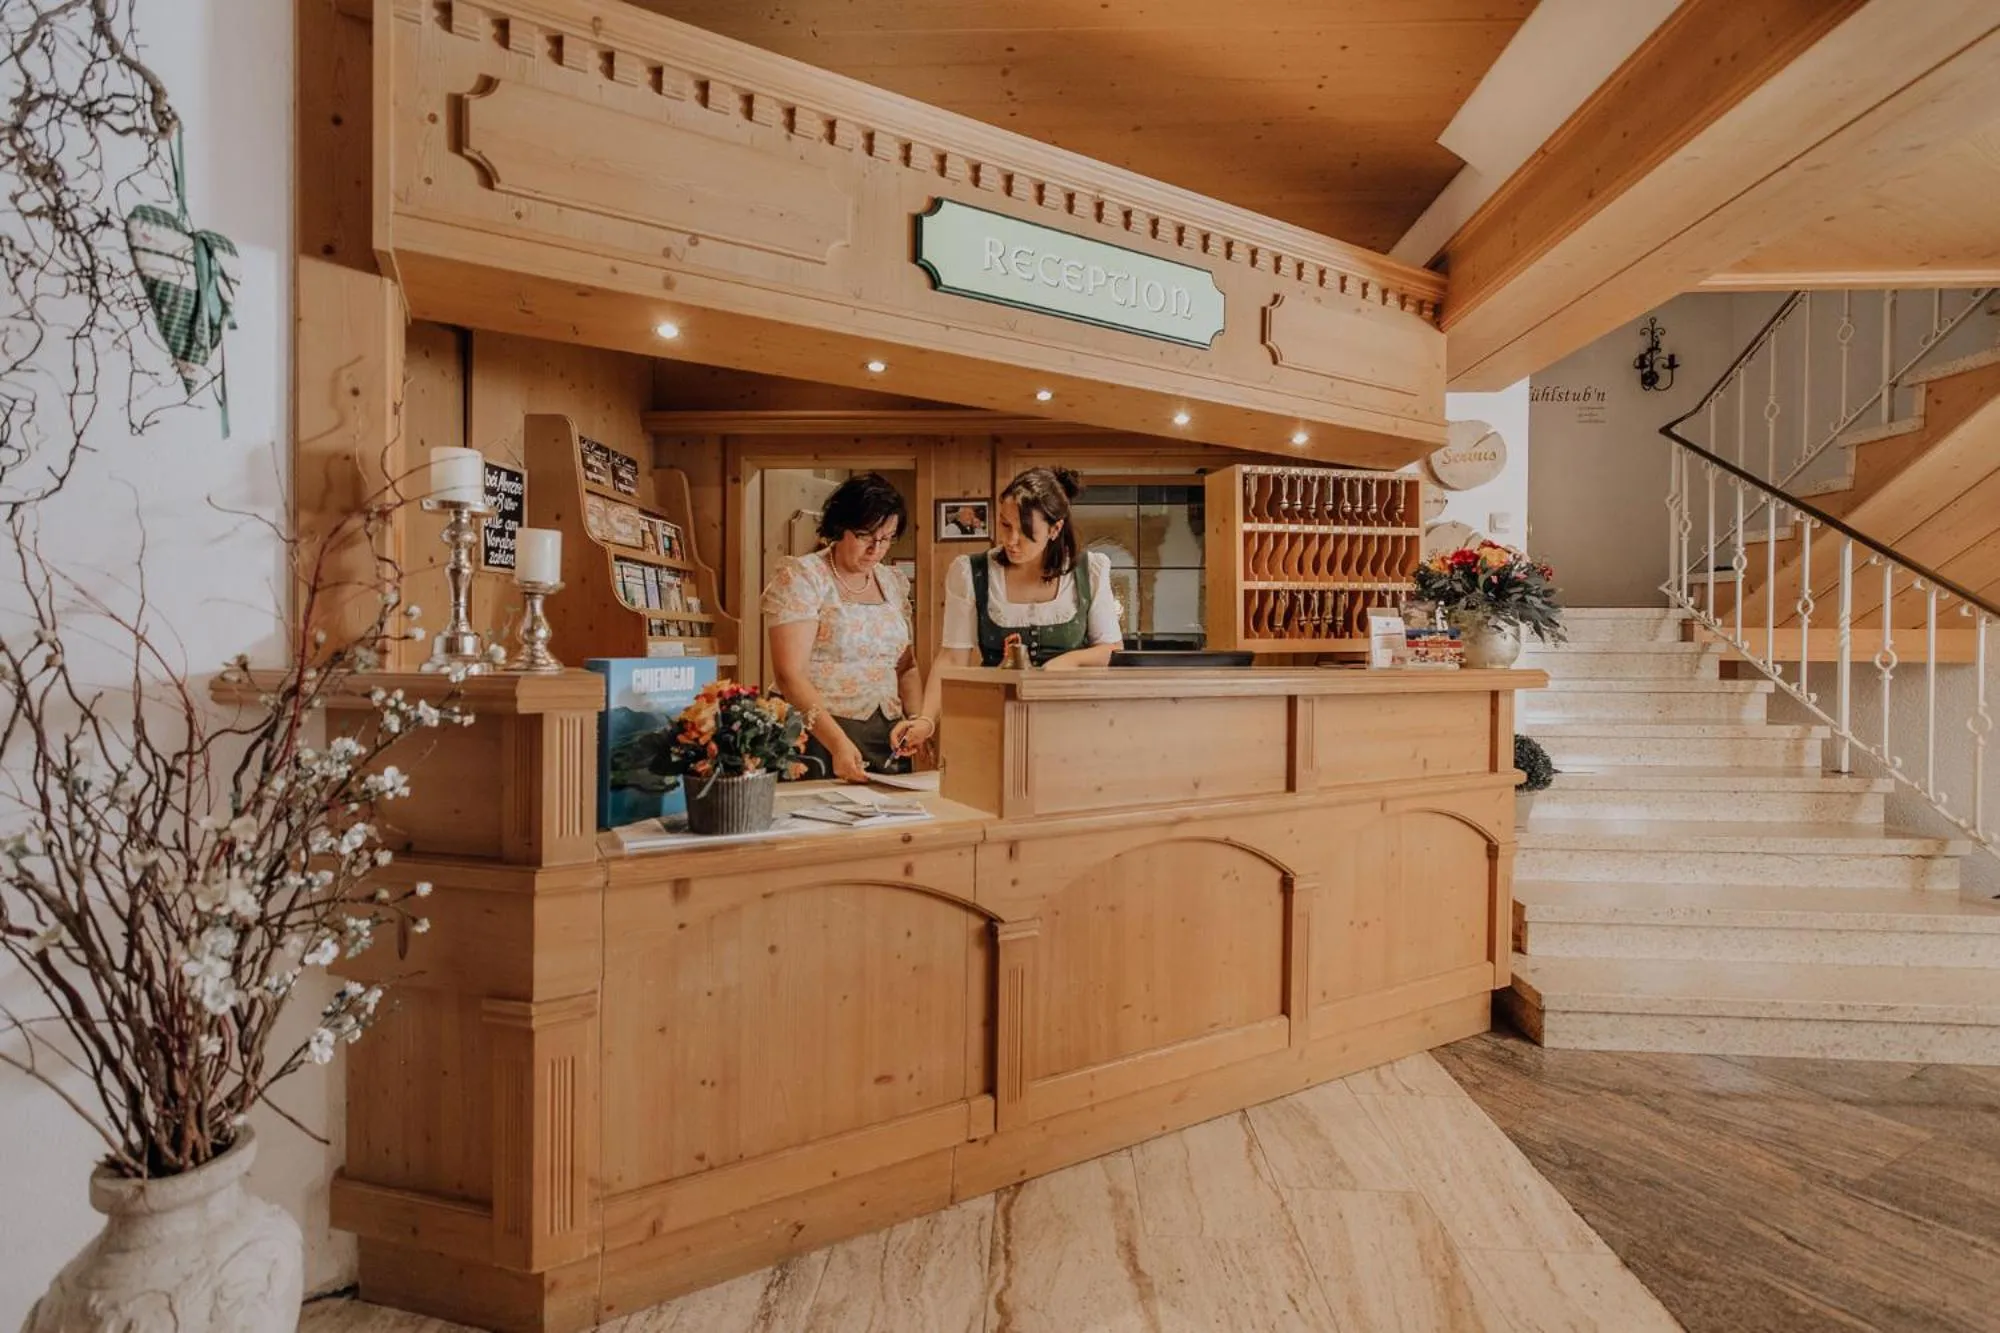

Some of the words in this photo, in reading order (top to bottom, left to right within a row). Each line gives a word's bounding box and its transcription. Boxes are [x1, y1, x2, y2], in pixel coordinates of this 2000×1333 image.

[983, 236, 1193, 321] RECEPTION
[1529, 385, 1606, 402] ühlstub'n
[632, 666, 696, 693] CHIEMGAU
